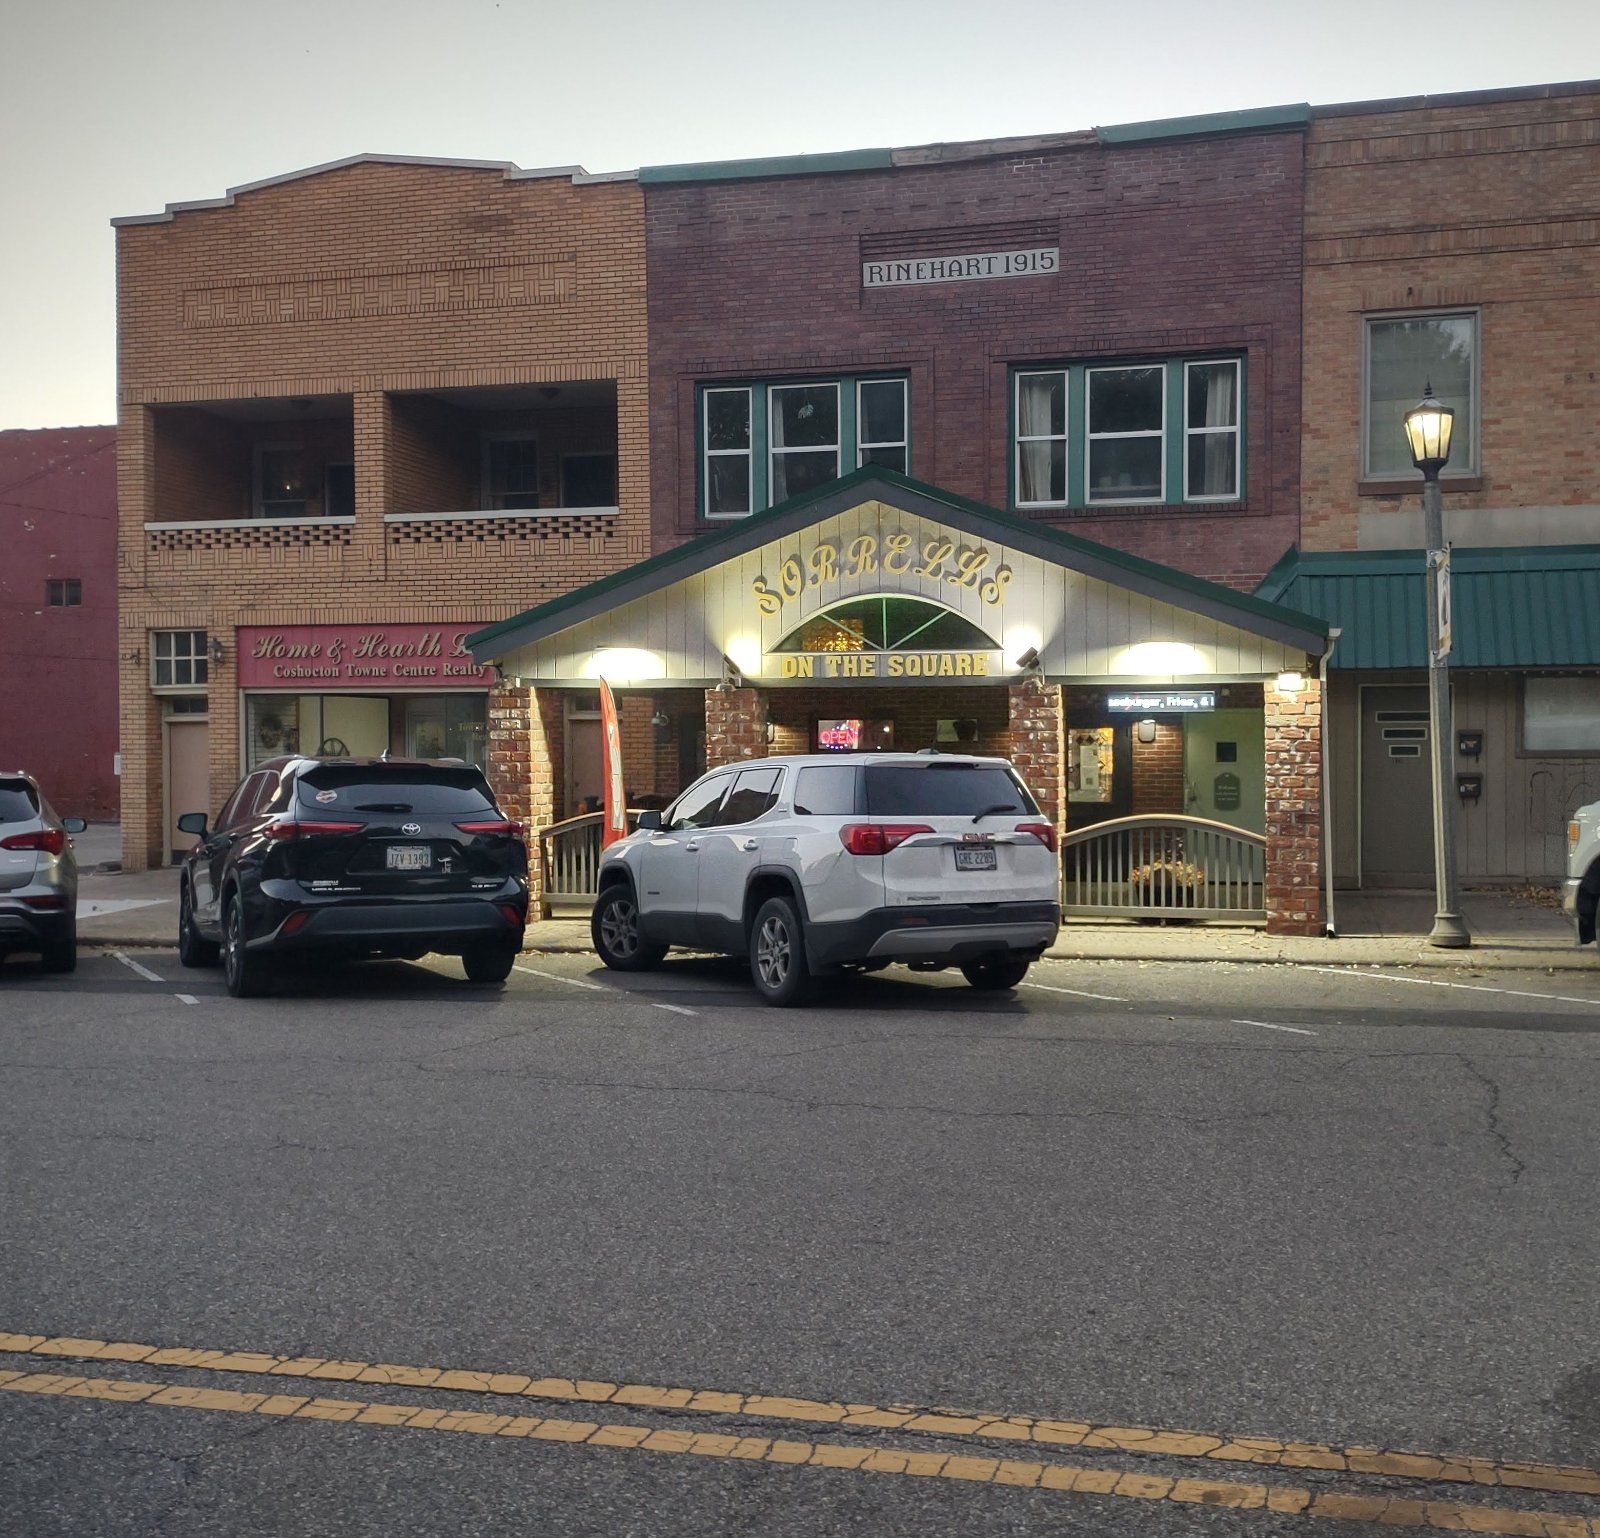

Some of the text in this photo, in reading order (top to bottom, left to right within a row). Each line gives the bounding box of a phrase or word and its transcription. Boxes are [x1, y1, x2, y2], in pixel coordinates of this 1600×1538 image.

[868, 251, 1055, 283] RINEHART 1915
[752, 533, 1014, 617] SORRELLS
[252, 634, 321, 659] Home
[326, 637, 346, 664] &
[352, 632, 441, 658] Hearth
[273, 663, 486, 678] Coshocton Towne Centre Realty
[781, 653, 990, 678] ON THE SQUARE
[821, 730, 856, 744] OPEN
